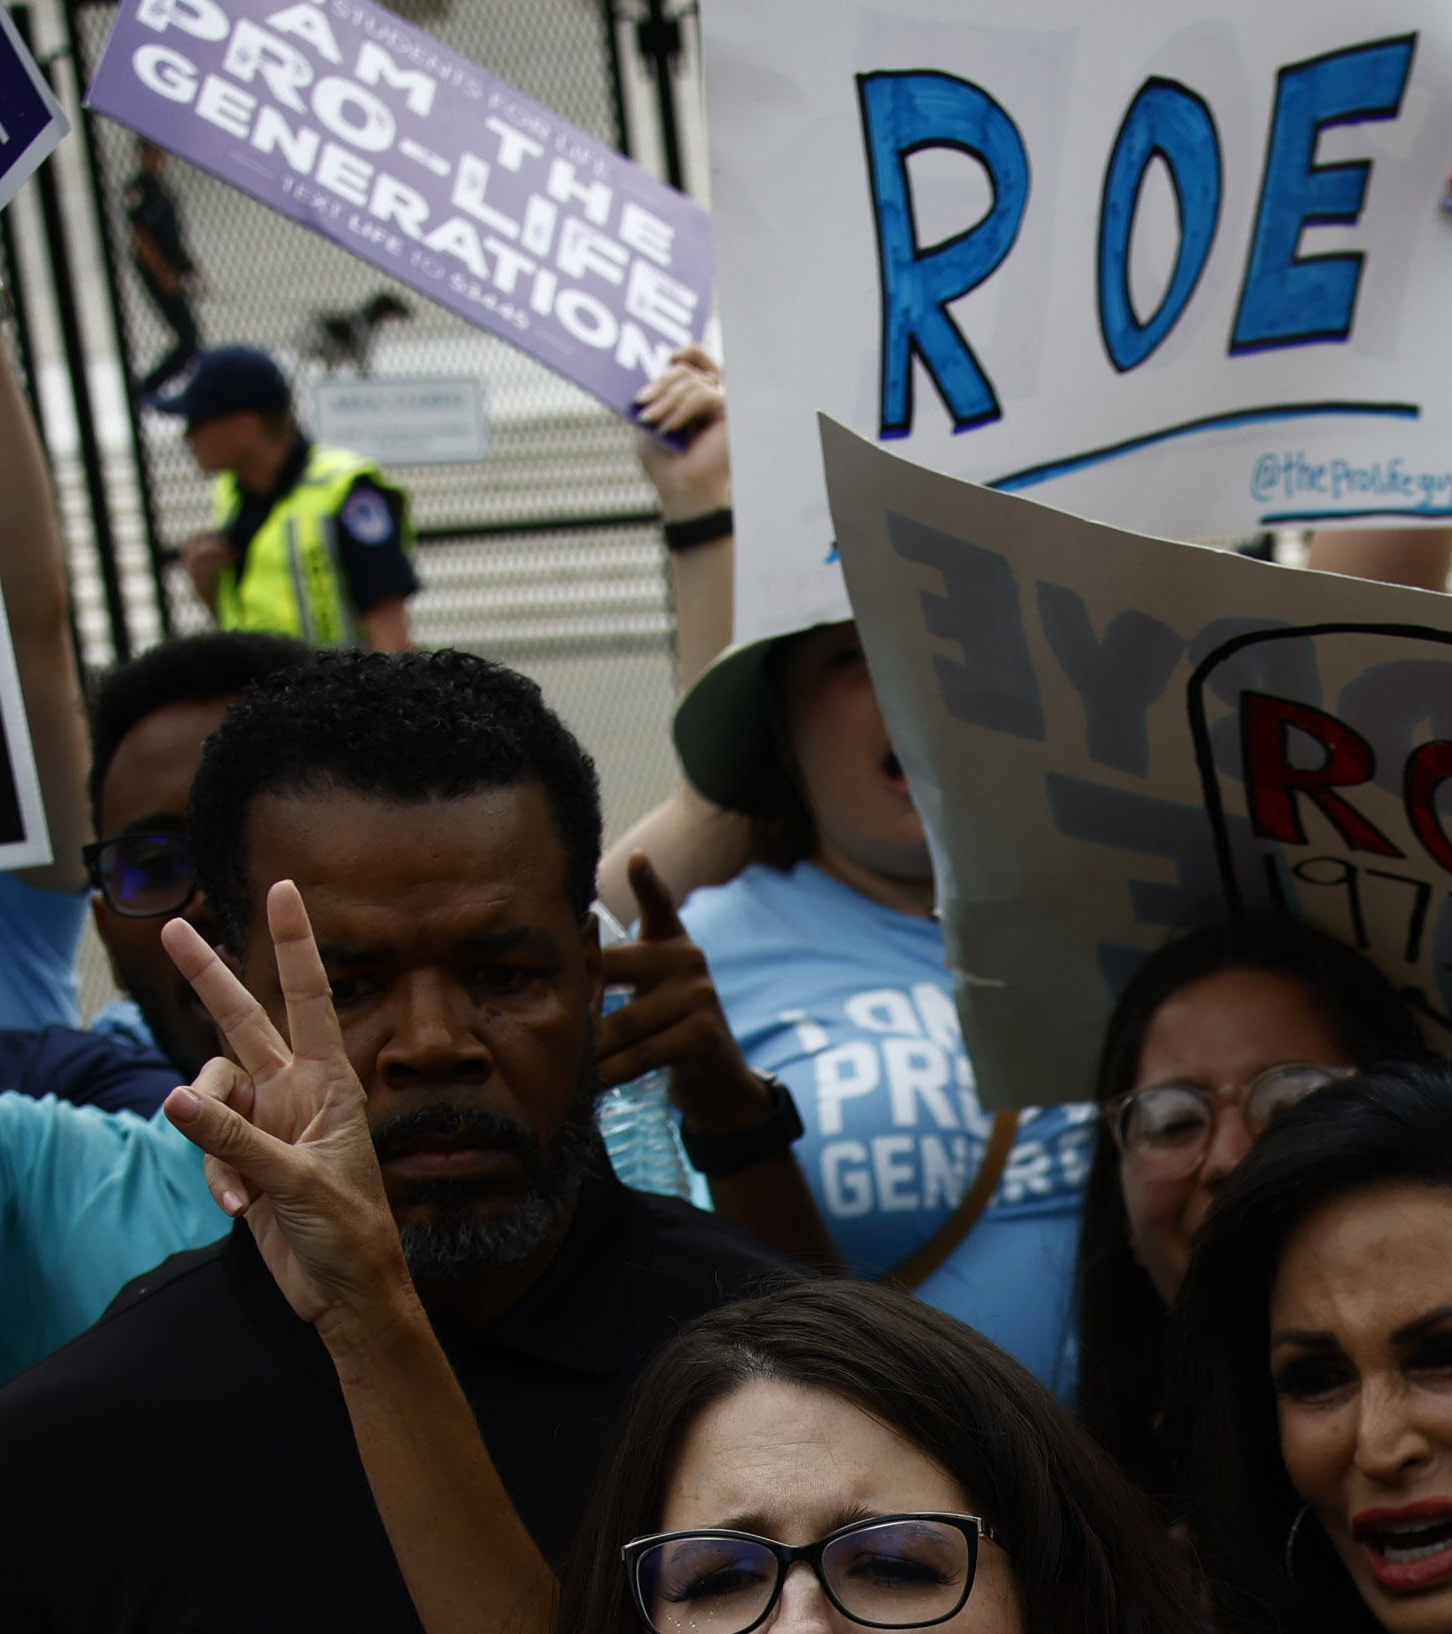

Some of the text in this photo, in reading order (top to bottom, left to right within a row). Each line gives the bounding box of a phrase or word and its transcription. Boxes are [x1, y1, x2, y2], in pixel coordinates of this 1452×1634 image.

[132, 44, 680, 380] GENERATION
[135, 0, 698, 347] PRO-LIFE
[282, 174, 343, 219] TEXT
[349, 212, 403, 257] LIFE
[410, 249, 446, 279] TO
[485, 117, 675, 266] THE
[856, 32, 1419, 440] ROE
